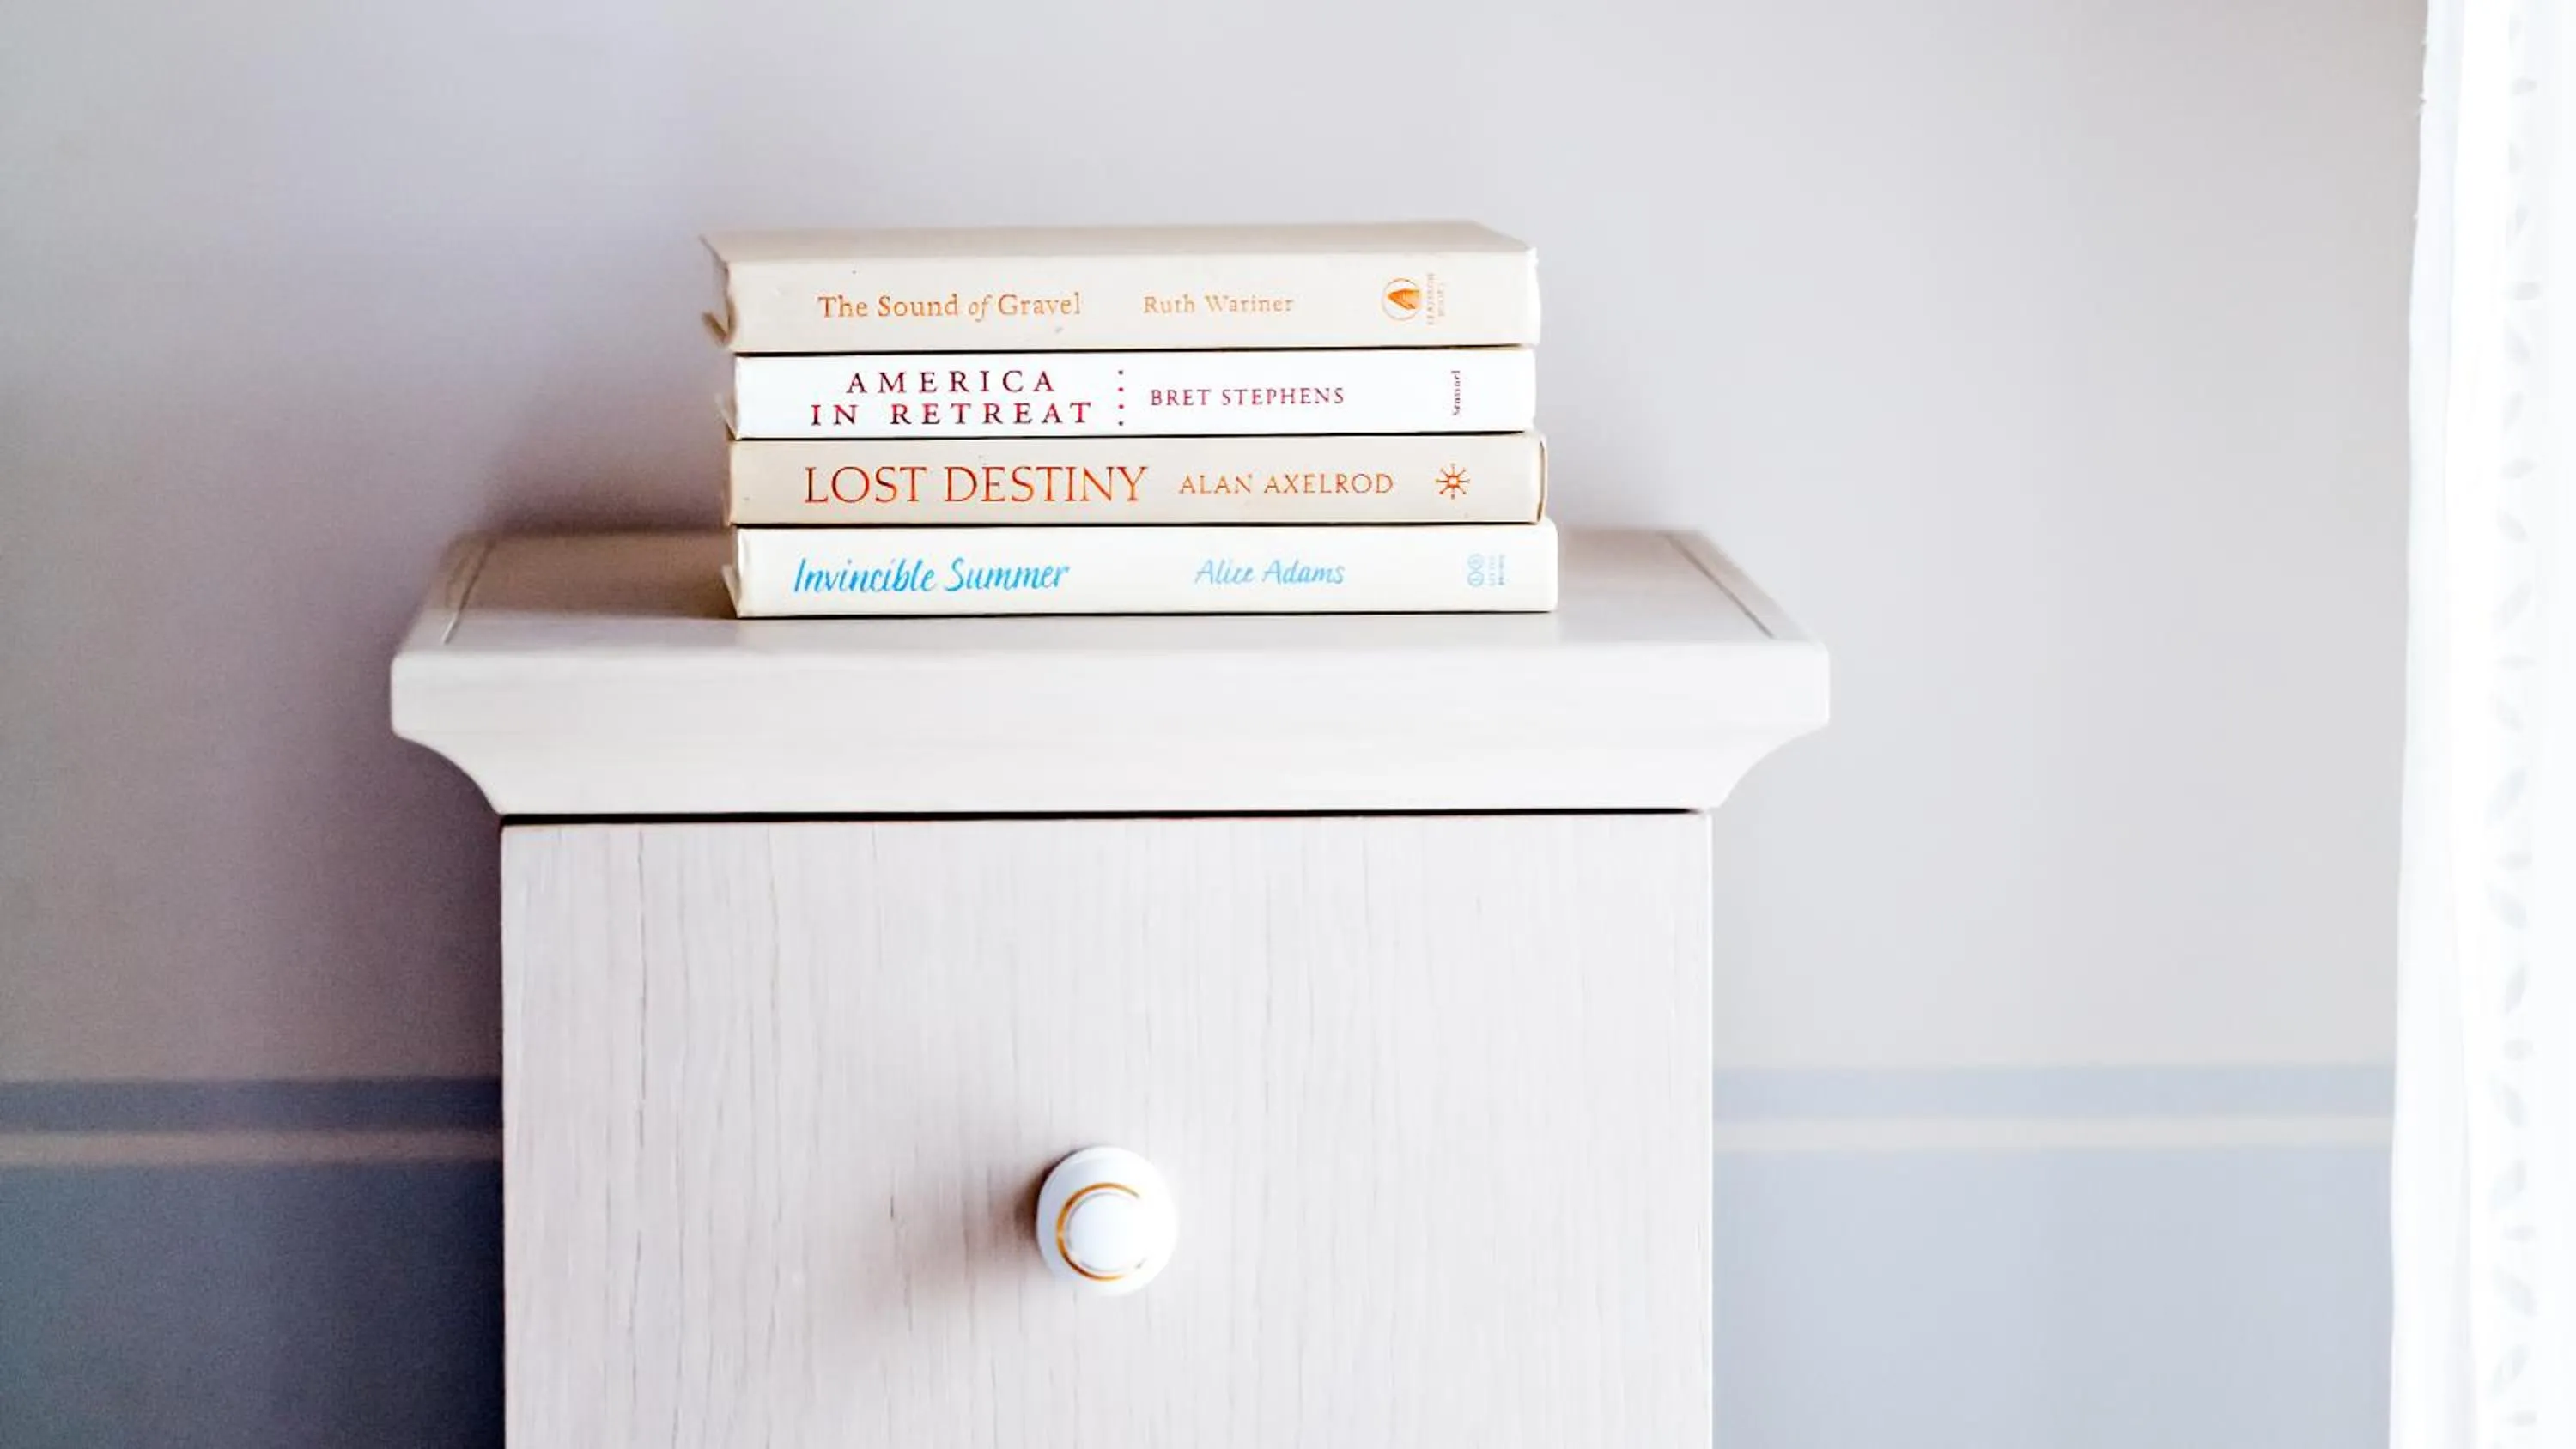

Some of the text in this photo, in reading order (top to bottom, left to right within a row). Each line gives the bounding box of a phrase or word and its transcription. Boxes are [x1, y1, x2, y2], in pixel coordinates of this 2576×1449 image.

[818, 291, 1081, 324] The Sound of Gravel
[1143, 293, 1294, 314] Ruth Wariner
[846, 370, 1055, 394] AMERICA
[1151, 387, 1344, 407] BRET STEPHENS
[811, 402, 1091, 427] IN RETREAT
[804, 465, 1148, 504] LOST DESTINY
[1178, 472, 1394, 495] ALAN AXELROD
[793, 556, 1070, 593] Invincible Summer
[1194, 559, 1345, 585] Alice Adams
